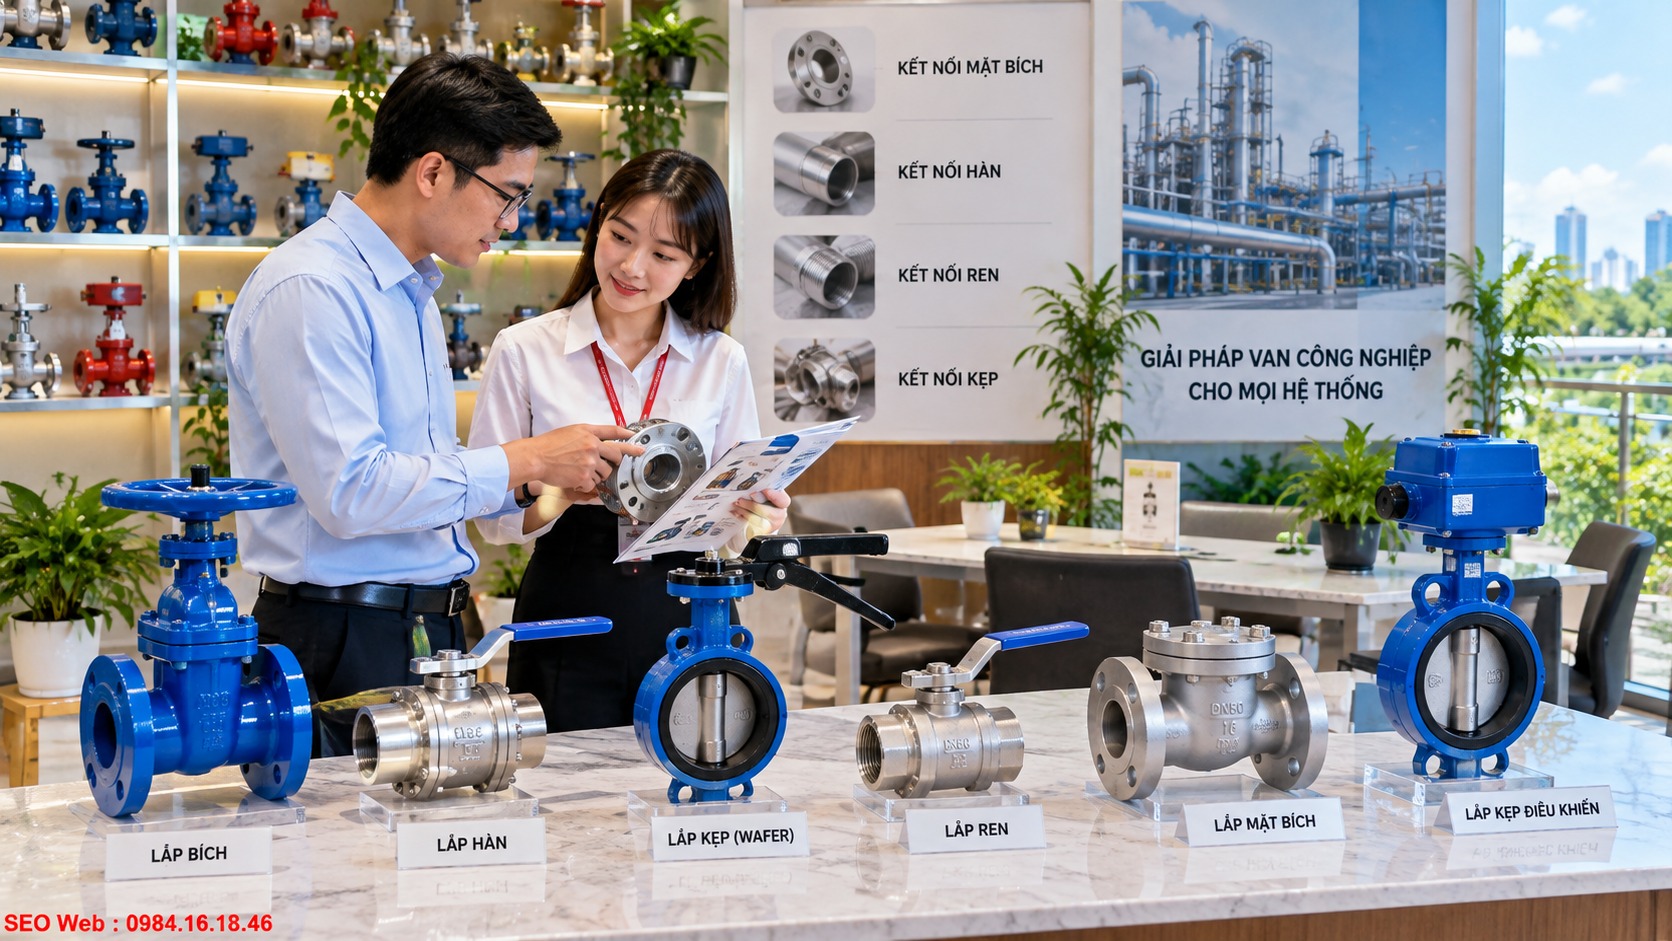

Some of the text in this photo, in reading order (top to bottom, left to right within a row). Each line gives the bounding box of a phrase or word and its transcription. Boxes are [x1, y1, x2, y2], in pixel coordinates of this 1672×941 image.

[898, 56, 1043, 78] KẾT NỐI MẶT BÍCH
[898, 160, 1001, 179] KẾT NỐI HÀN
[898, 263, 999, 282] KẾT NỐI REN
[1140, 343, 1432, 371] GIẢI PHÁP VAN CÔNG NGHIỆP
[898, 367, 999, 389] KẾT NỐI KẸP
[1188, 374, 1383, 405] CHO MỌI HỆ THỐNG
[1494, 805, 1521, 823] KẸP
[1558, 797, 1601, 817] KHIẾN
[978, 822, 1009, 837] REN
[1246, 813, 1278, 834] MẶT
[1281, 812, 1316, 829] BÍCH
[472, 832, 507, 851] HÀN
[701, 830, 730, 848] KẸP
[734, 827, 795, 846] (WAFER)
[188, 843, 227, 861] BÍCH
